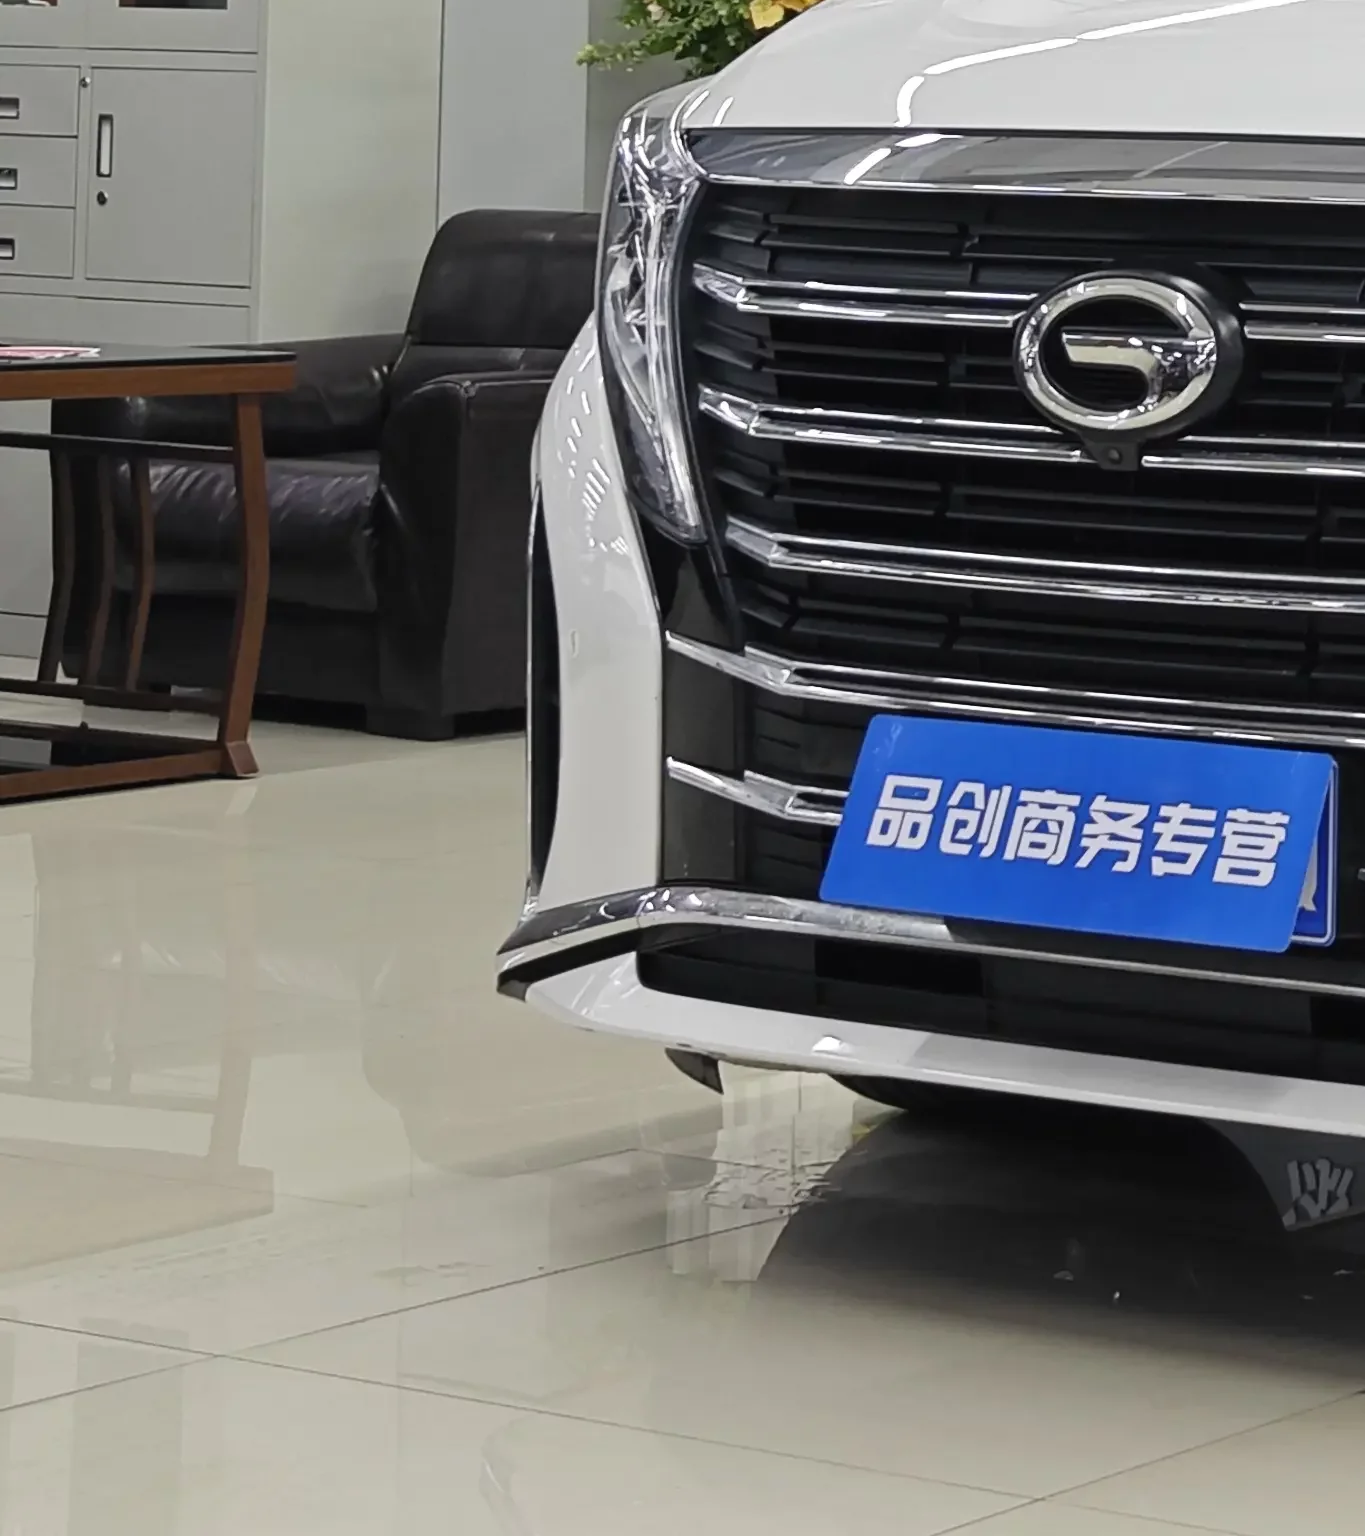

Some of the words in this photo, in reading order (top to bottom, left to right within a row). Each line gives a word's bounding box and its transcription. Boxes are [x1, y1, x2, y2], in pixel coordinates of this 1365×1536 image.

[865, 773, 1291, 888] 品创商务专营
